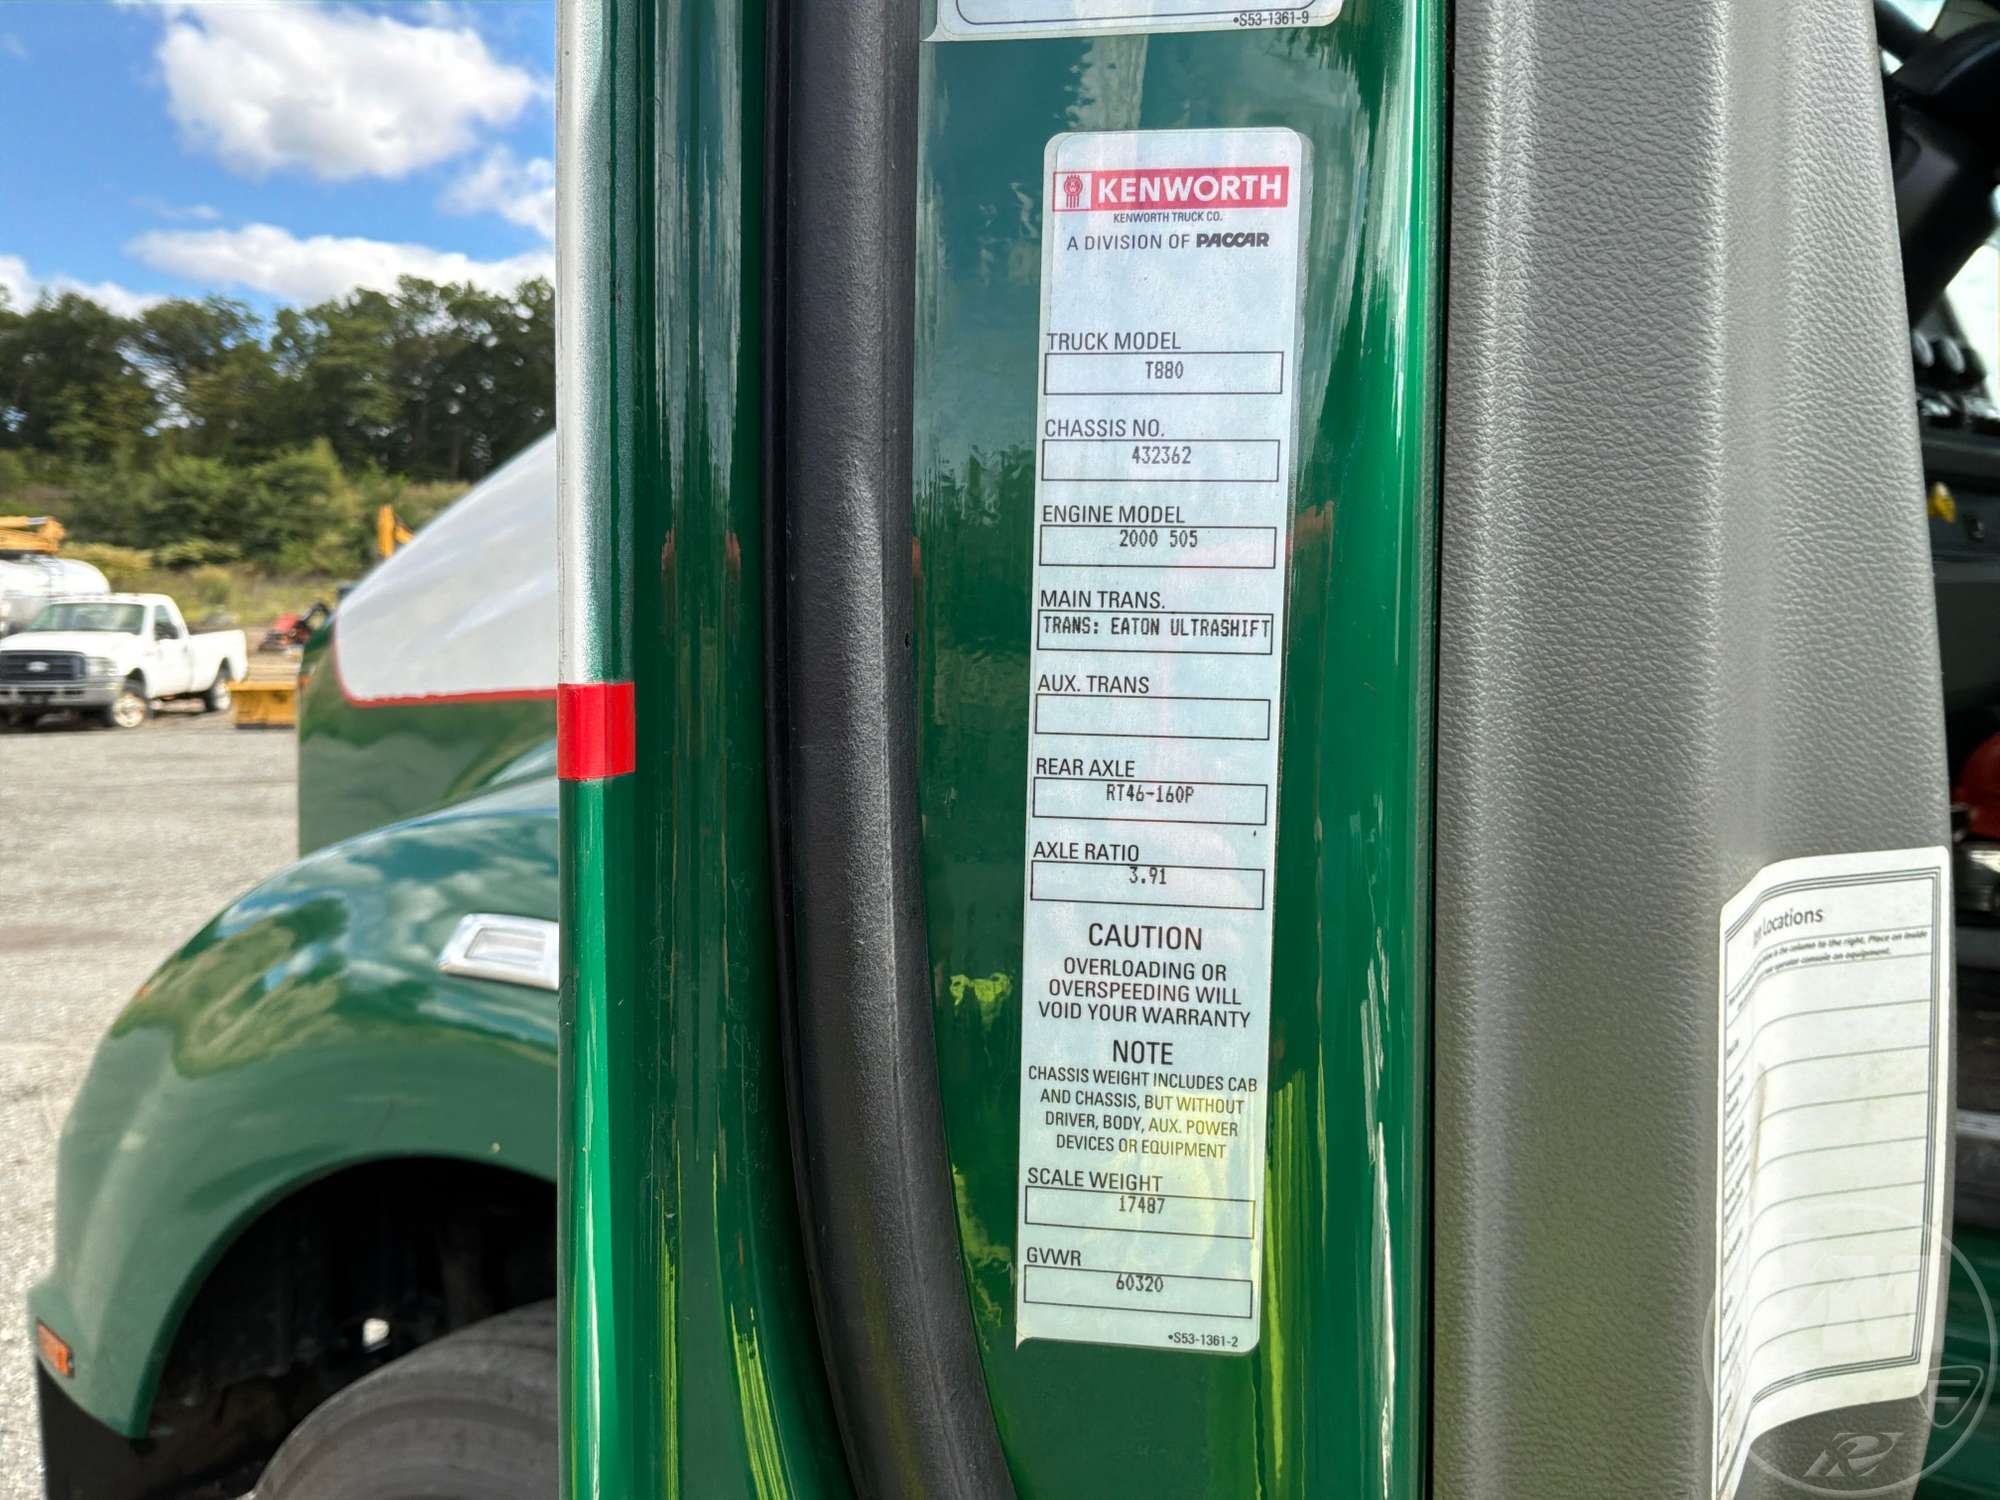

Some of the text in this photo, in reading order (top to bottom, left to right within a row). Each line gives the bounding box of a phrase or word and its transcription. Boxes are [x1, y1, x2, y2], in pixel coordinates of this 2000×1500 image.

[1098, 174, 1282, 204] KENWORTH
[1113, 210, 1223, 223] KENWORTH TRUCK CO.
[1066, 232, 1270, 251] A DIVISION OF PACCAR
[1046, 331, 1182, 350] TRUCK MODEL
[1145, 360, 1184, 379] T880
[1044, 418, 1165, 437] CHASSIS NO.
[1132, 445, 1192, 464] 432362
[1042, 505, 1186, 524] ENGINE MODEL
[1119, 529, 1199, 548] 2000 505
[1040, 590, 1166, 609] MAIN TRANS.
[1043, 616, 1271, 638] TRANS: EATON ULTRASHIFT
[1037, 674, 1150, 694] AUX. TRANS
[1036, 757, 1136, 778] REAR AXLE
[1106, 783, 1195, 804] RT46-160P
[1033, 841, 1140, 862] AXLE RATIO
[1128, 866, 1167, 885] 3.91
[1763, 908, 1824, 936] Locations
[1088, 922, 1203, 951] CAUTION
[1064, 957, 1227, 981] OVERLOADING OR
[1049, 978, 1242, 1005] OVERSPEEDING WILL
[1038, 1001, 1251, 1028] VOID YOUR WARRANTY
[1112, 1039, 1174, 1066] NOTE
[1028, 1065, 1257, 1093] CHASSIS WEIGHT INCLUDES CAB
[1040, 1088, 1245, 1115] AND CHASSIS, BUT WITHOUT
[1045, 1110, 1238, 1137] DRIVER, BODY, AUX. POWER
[1056, 1134, 1227, 1159] DEVICES OR EQUIPMENT
[1027, 1167, 1163, 1193] SCALE WEIGHT
[1118, 1195, 1165, 1214] 17487
[1026, 1247, 1082, 1267] GVWR
[1116, 1273, 1164, 1293] 60320
